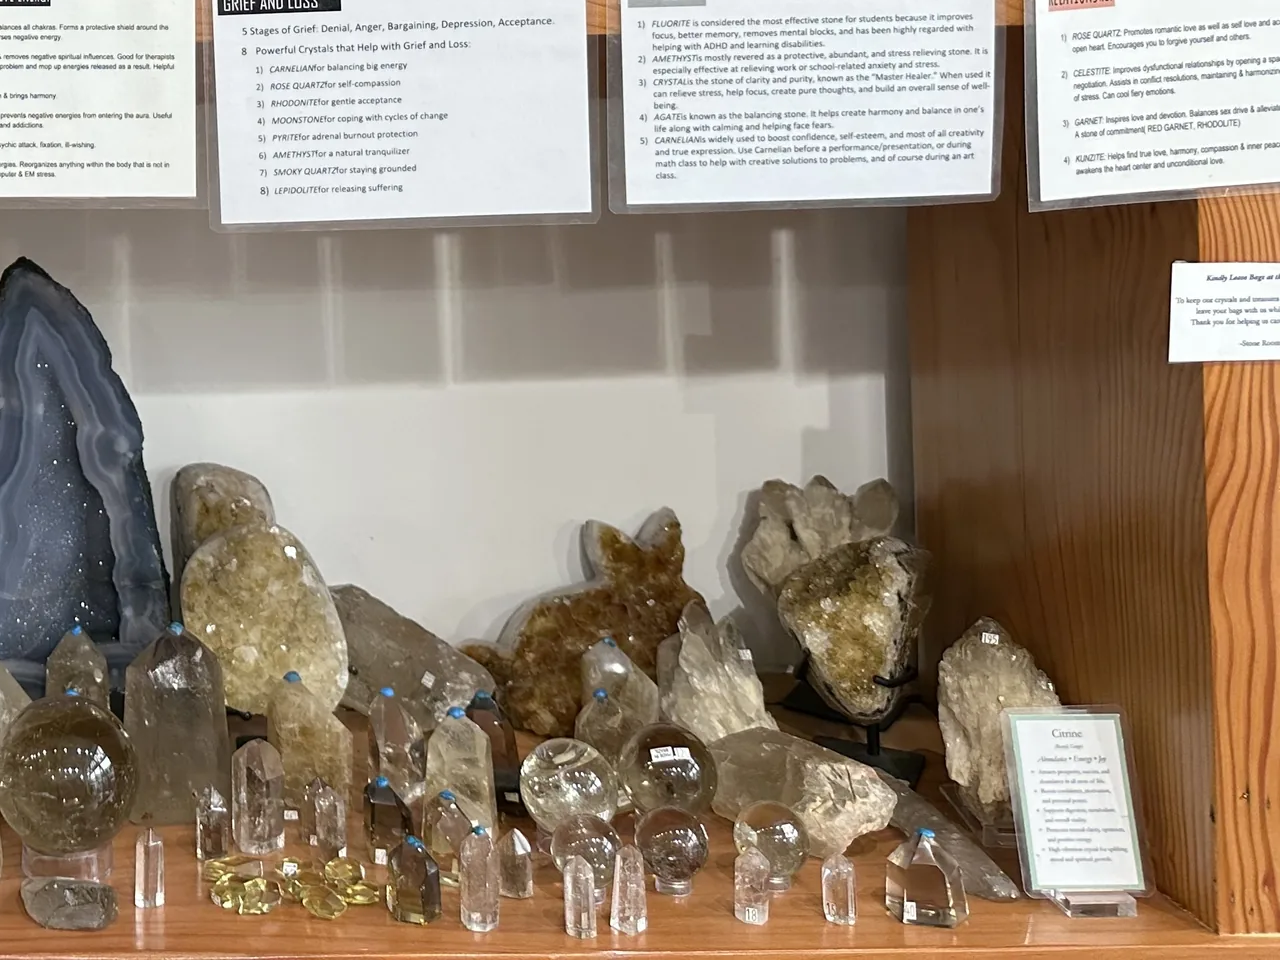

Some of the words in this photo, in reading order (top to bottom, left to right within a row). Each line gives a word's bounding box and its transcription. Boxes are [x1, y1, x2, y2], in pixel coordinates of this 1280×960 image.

[637, 20, 646, 30] 1)
[651, 19, 691, 29] FLUORITE
[700, 18, 745, 27] considered
[747, 17, 761, 26] the
[762, 18, 783, 26] most
[784, 16, 820, 26] effective
[845, 15, 857, 24] for
[858, 15, 894, 24] students
[895, 14, 928, 23] because
[937, 13, 974, 22] improves
[242, 27, 248, 36] 5
[250, 27, 280, 37] Stages
[281, 25, 291, 35] of
[1072, 45, 1088, 54] open
[1107, 41, 1145, 51] Encourages
[1145, 40, 1158, 50] you
[1166, 38, 1188, 48] forgive
[1189, 34, 1215, 47] yourself
[1215, 34, 1228, 43] and
[3, 92, 8, 100] &
[9, 93, 29, 101] brings
[1249, 274, 1265, 282] Bags
[1191, 318, 1211, 326] Thank
[1051, 729, 1083, 738] Citrine
